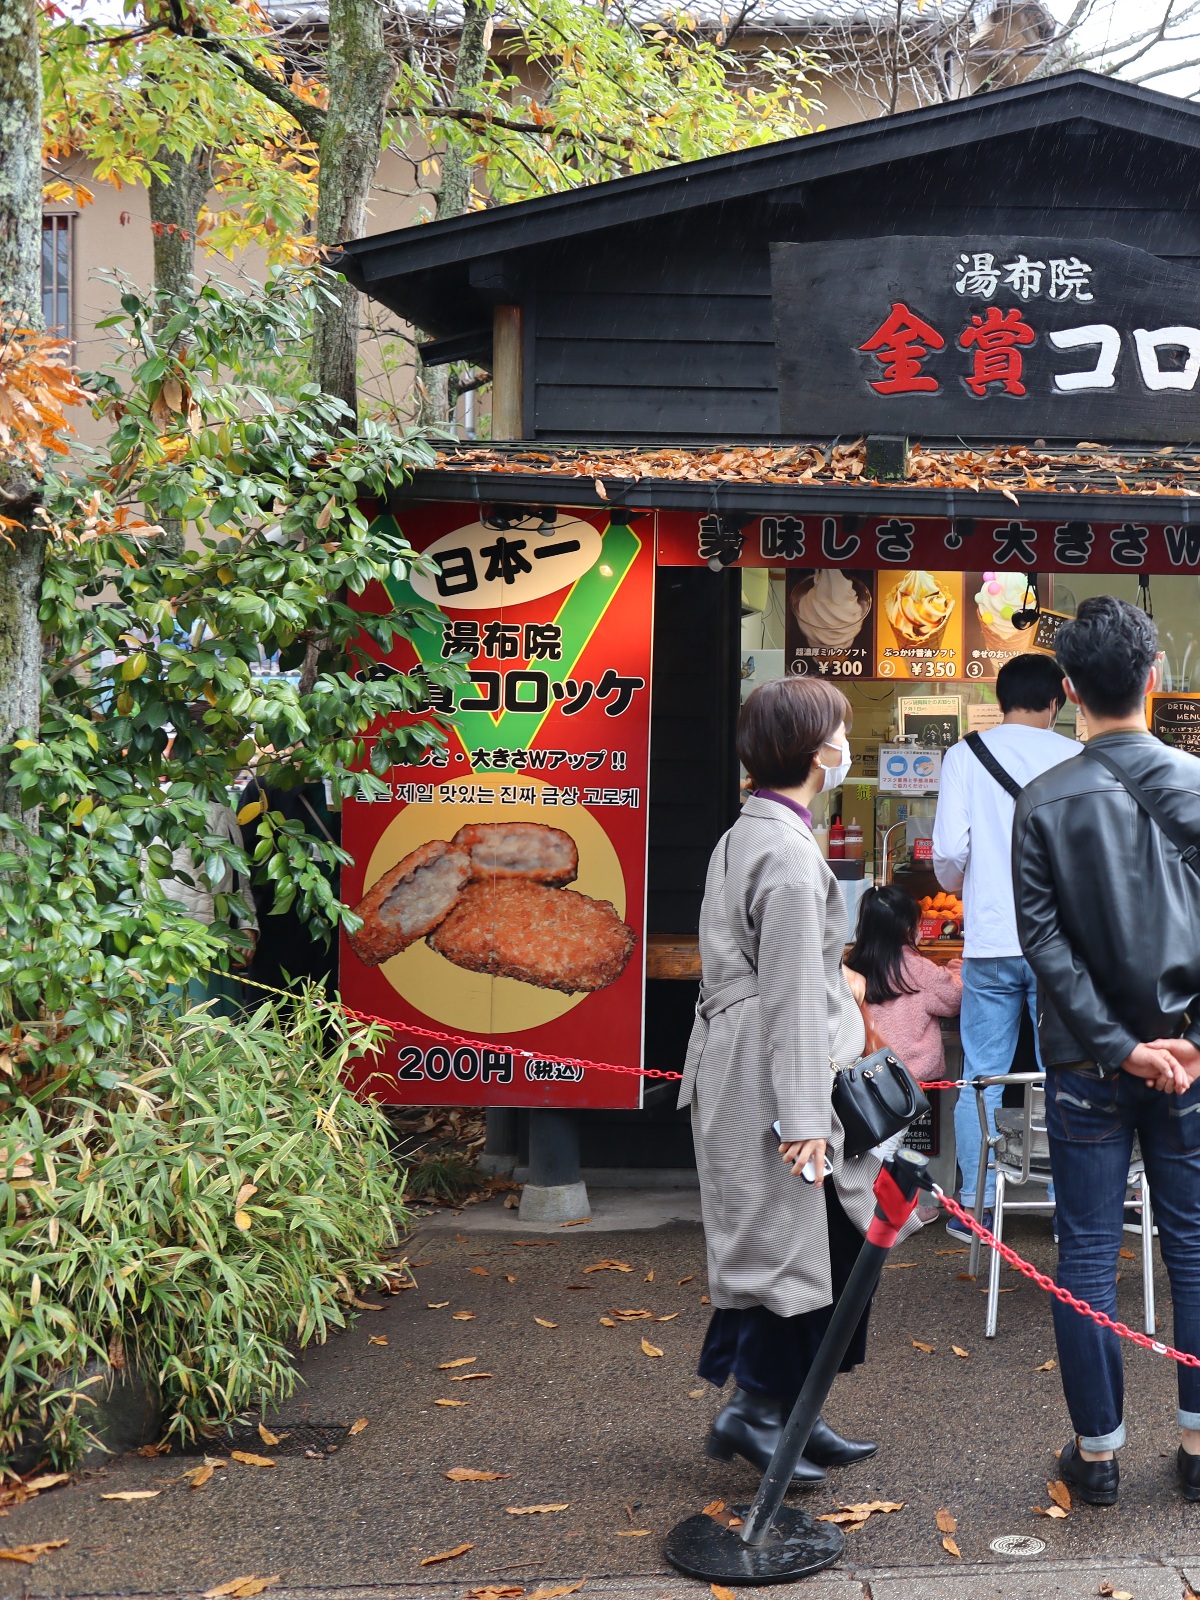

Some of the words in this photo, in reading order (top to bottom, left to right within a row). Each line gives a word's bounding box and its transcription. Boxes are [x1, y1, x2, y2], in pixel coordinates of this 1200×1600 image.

[955, 252, 1094, 302] 湯布院
[431, 536, 582, 597] 日本一
[441, 620, 562, 661] 湯布院
[883, 648, 956, 658] ぶっかけ醤油ソフト
[1167, 703, 1196, 711] DRINK
[396, 782, 435, 804] 제일
[439, 783, 495, 805] 맛있는
[499, 785, 537, 806] 진짜
[541, 786, 579, 807] 금상
[582, 787, 640, 809] 고로케
[397, 1046, 514, 1084] 200円
